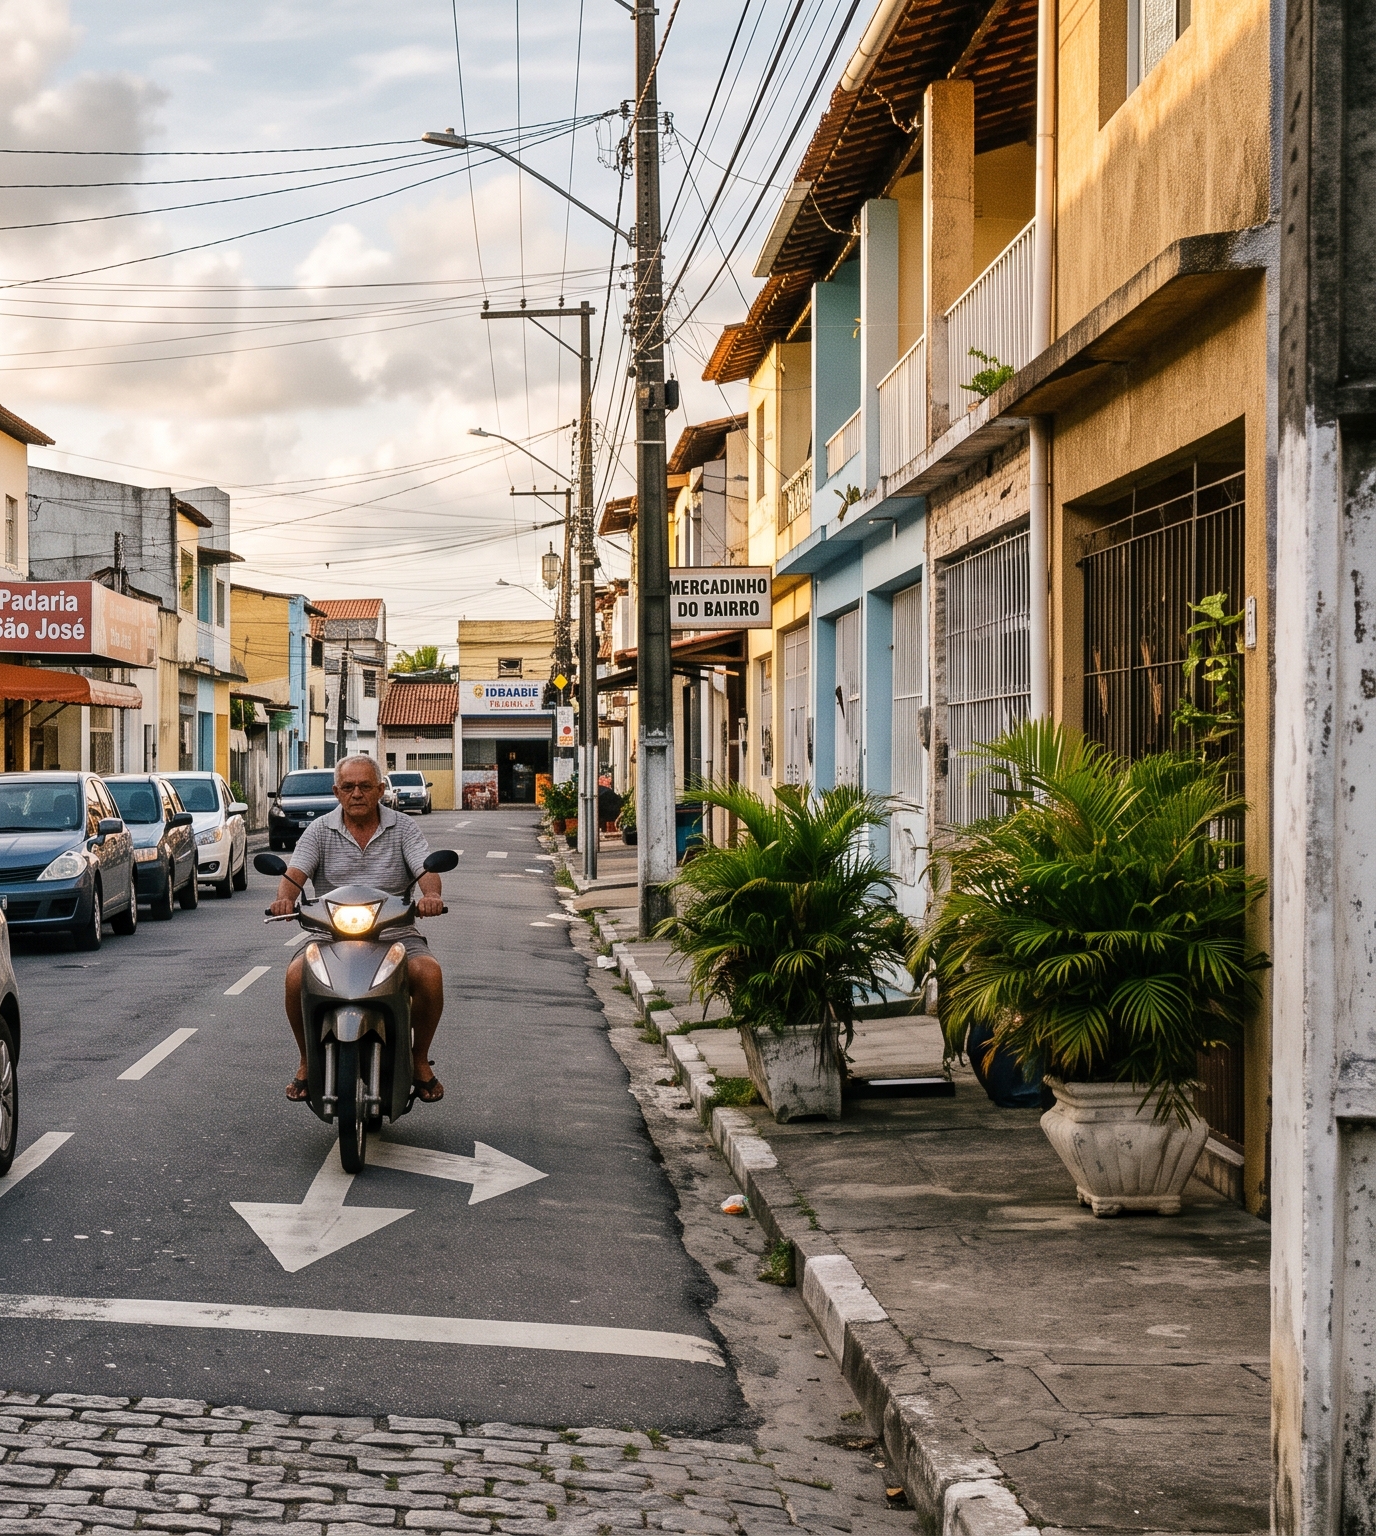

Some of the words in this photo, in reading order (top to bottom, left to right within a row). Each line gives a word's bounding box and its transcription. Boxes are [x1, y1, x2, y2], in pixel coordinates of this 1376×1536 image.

[670, 578, 767, 595] MERCADINHO
[678, 602, 698, 617] DO
[704, 600, 759, 616] BAIRRO
[35, 618, 85, 640] José
